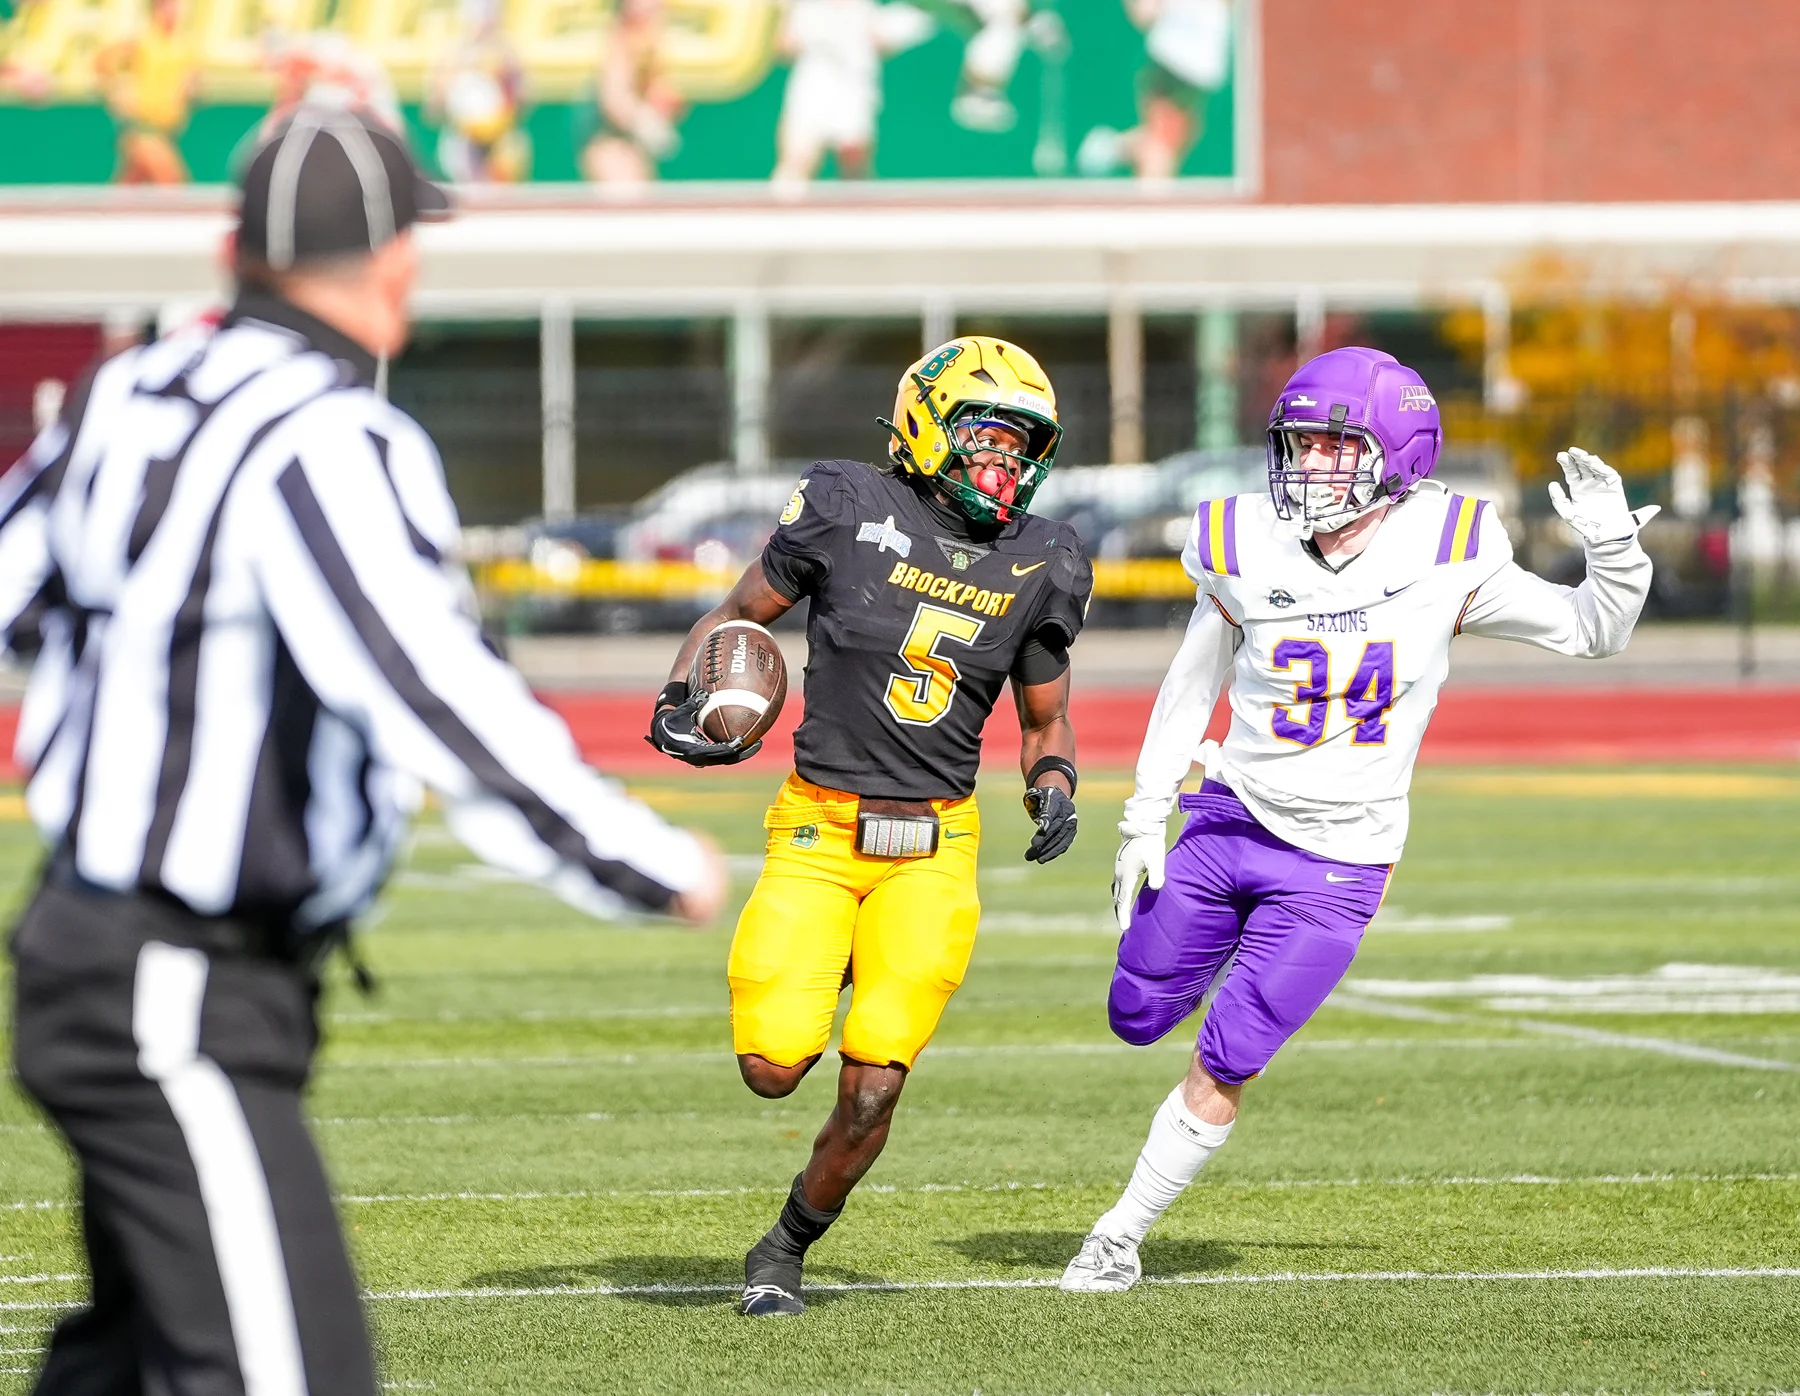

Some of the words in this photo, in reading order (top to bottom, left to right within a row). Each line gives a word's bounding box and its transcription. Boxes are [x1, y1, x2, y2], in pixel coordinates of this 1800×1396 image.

[917, 345, 965, 382] B
[1018, 395, 1051, 415] Riddell
[779, 479, 810, 525] 5
[952, 551, 969, 570] B
[888, 561, 1015, 617] BROCKPORT
[1307, 611, 1368, 633] SAXONS
[730, 634, 748, 674] Wilson
[883, 601, 986, 727] 5
[1271, 636, 1396, 747] 34
[790, 824, 819, 849] B
